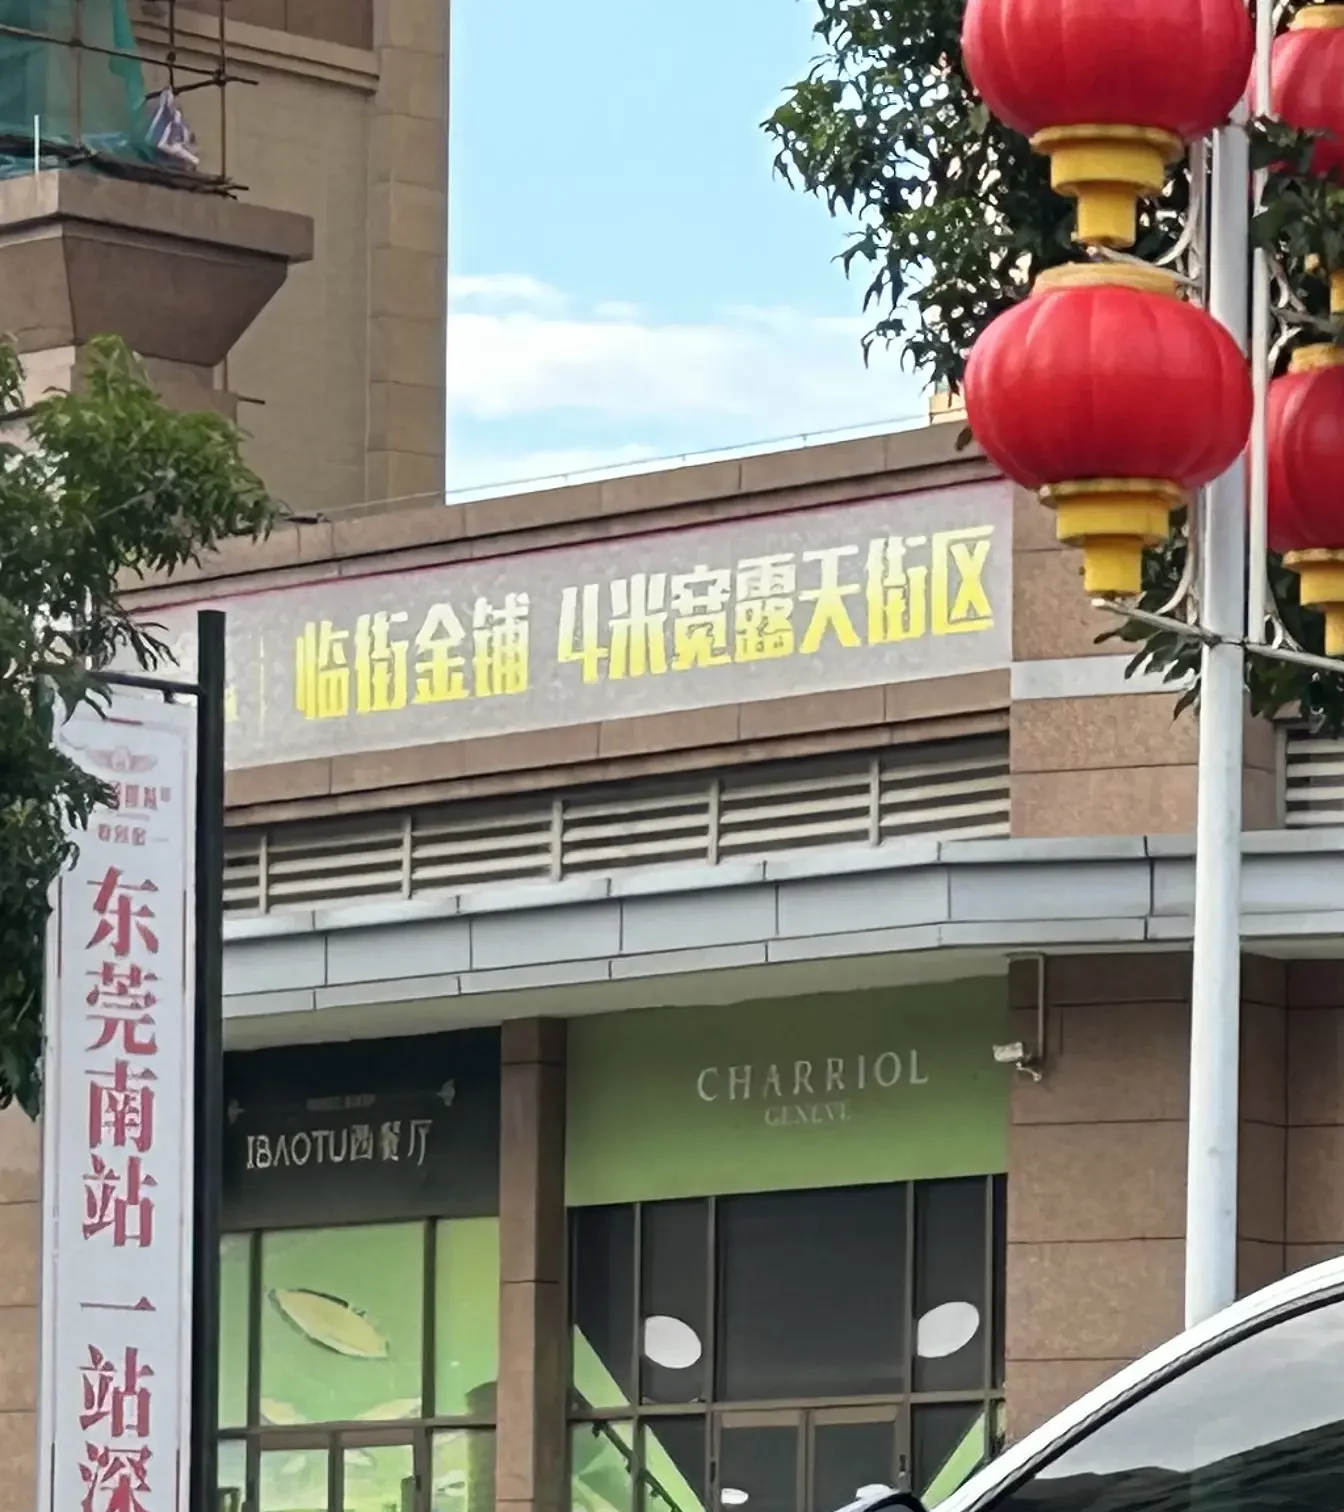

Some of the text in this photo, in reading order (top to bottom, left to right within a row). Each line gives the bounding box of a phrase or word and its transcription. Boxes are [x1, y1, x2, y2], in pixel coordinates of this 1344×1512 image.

[295, 592, 530, 720] 临街金铺
[557, 525, 995, 684] 4米宽露天街区
[697, 1049, 928, 1101] CHARRIOL
